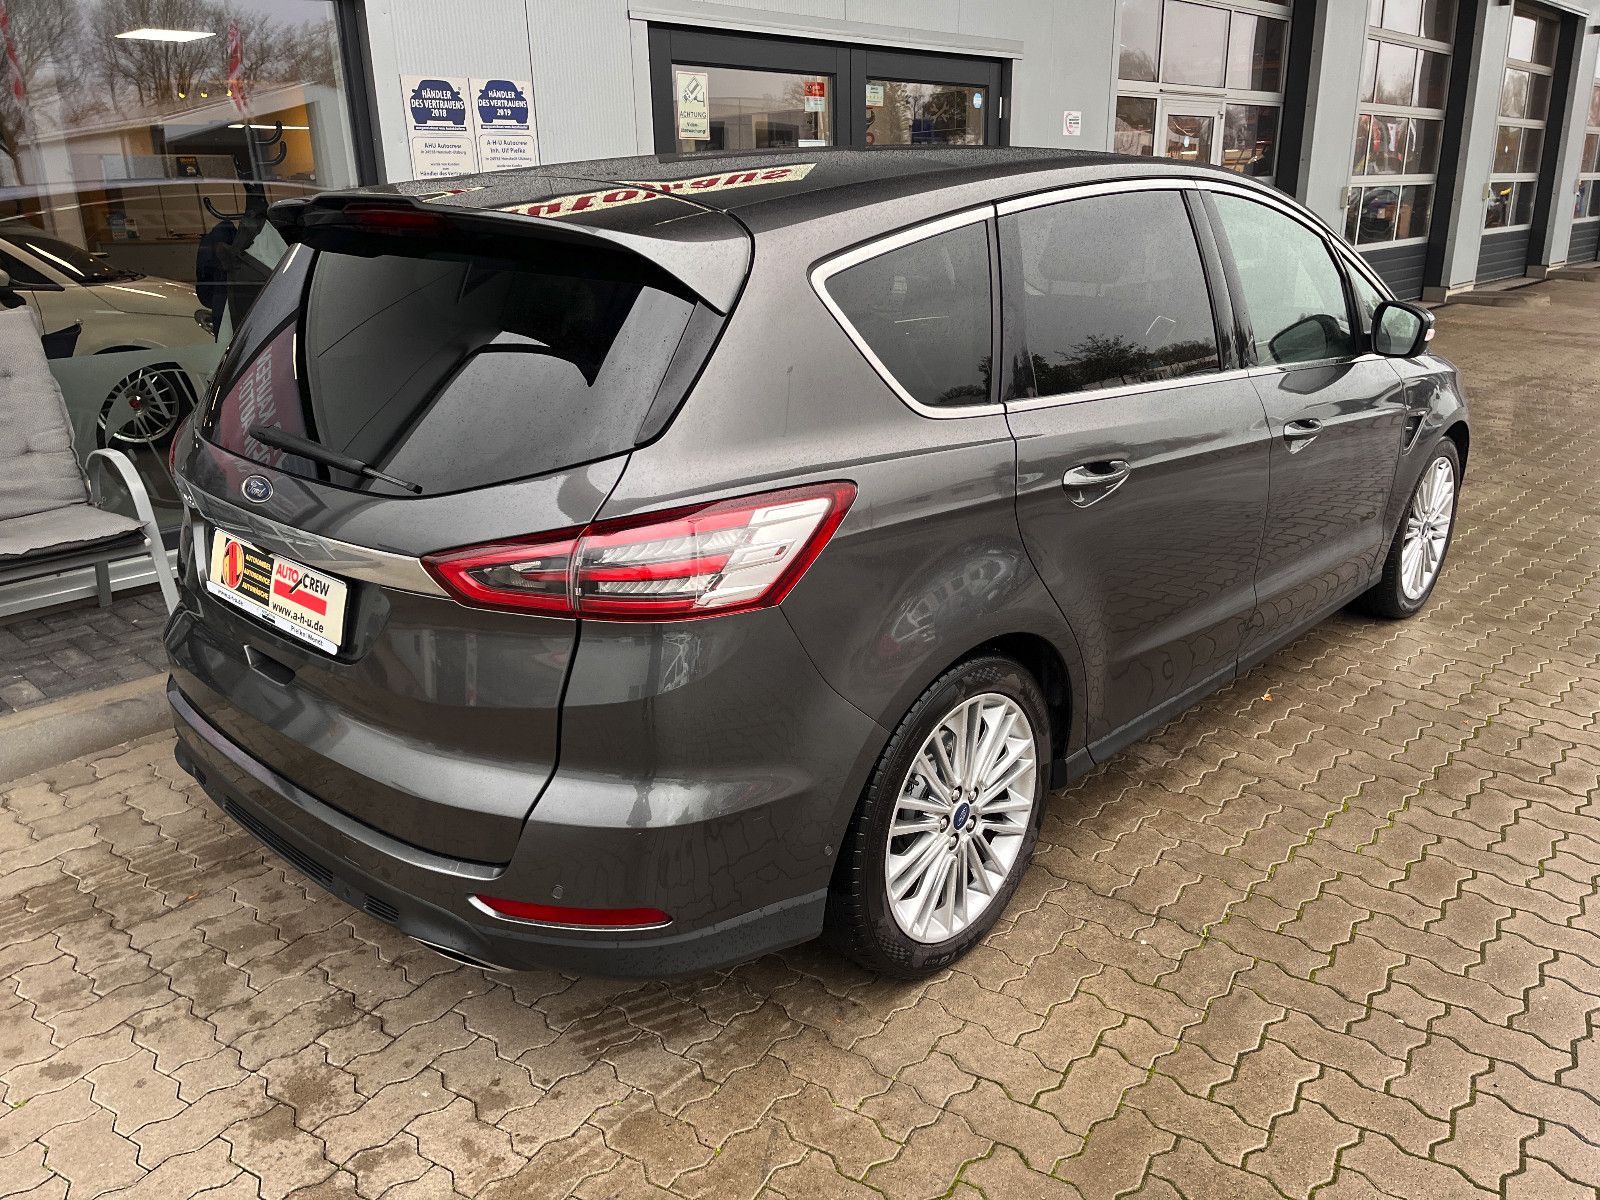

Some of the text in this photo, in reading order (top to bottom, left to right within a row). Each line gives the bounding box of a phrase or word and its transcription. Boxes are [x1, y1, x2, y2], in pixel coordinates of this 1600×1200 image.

[421, 88, 452, 99] HÄNDLER
[488, 89, 516, 99] HÄNDLER
[411, 99, 465, 110] DES VERTRAUENS
[478, 99, 527, 108] DES VERTRAUENS
[431, 109, 447, 117] 2018
[497, 108, 512, 116] 2019
[680, 110, 707, 119] ACHTUNG
[276, 563, 330, 597] AUTO CREW
[272, 601, 324, 634] www.a-h-u.de
